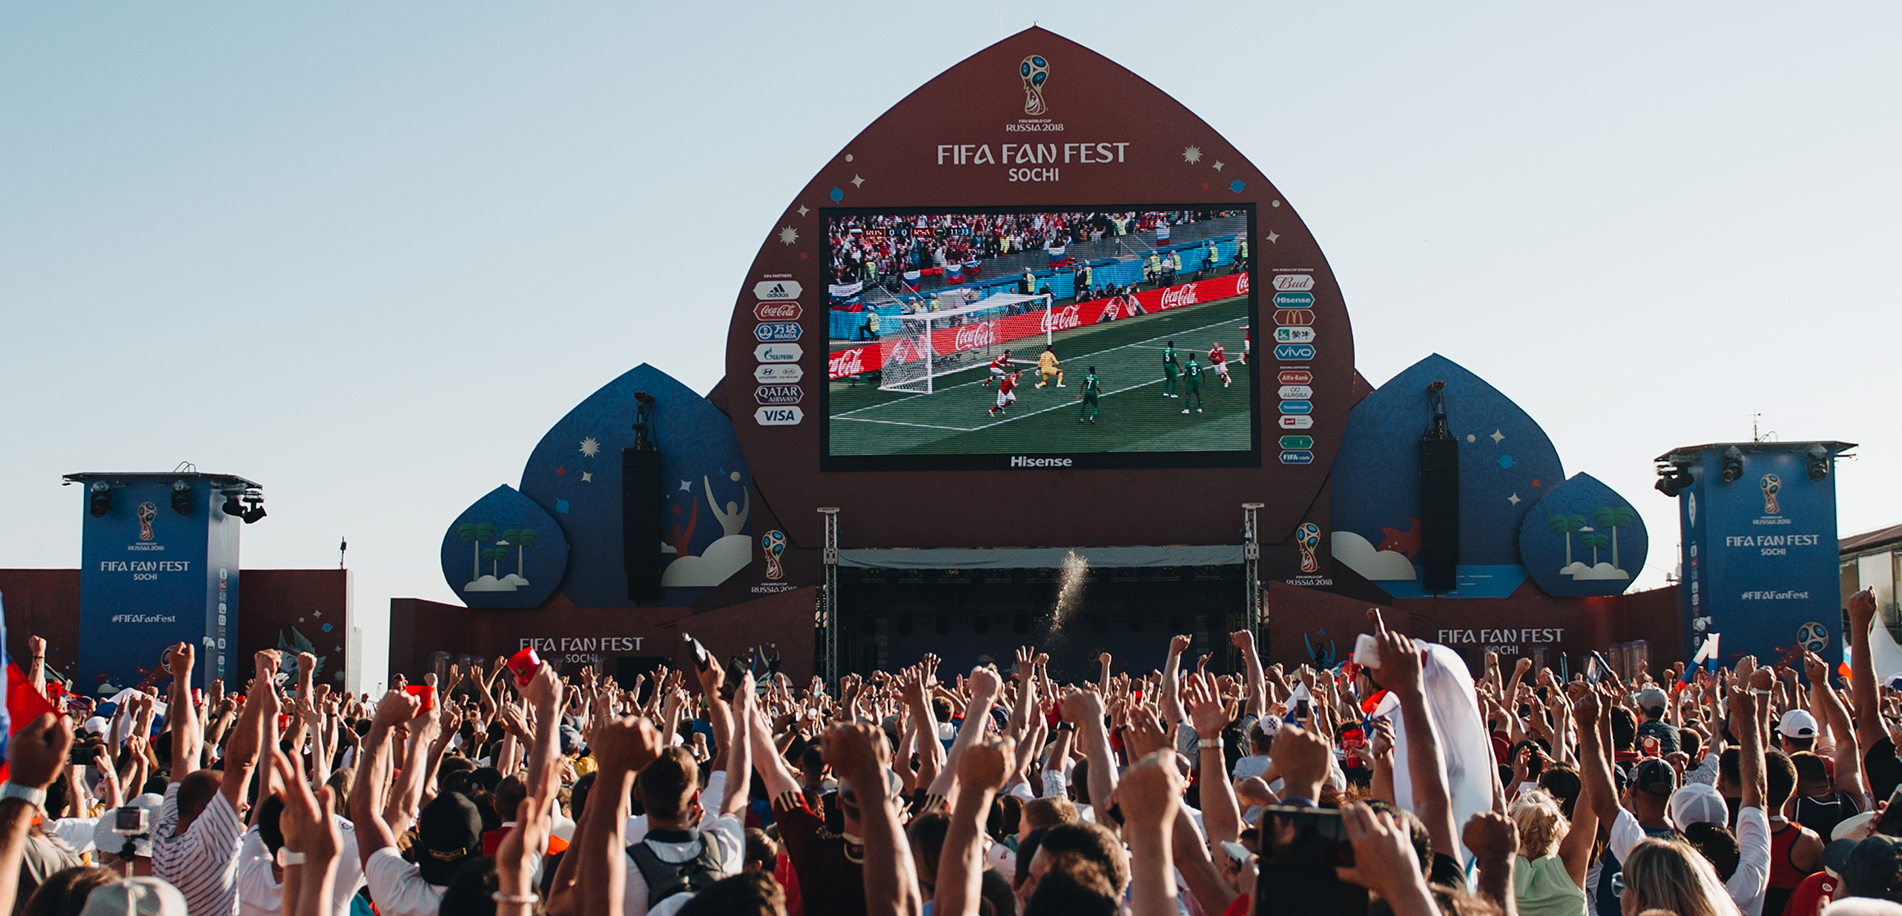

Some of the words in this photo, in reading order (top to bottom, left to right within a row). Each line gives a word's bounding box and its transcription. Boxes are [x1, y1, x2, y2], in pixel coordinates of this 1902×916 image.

[1006, 124, 1041, 132] RUSSIA
[1042, 124, 1064, 132] 2018
[938, 144, 995, 165] FIFA
[1002, 144, 1056, 164] FAN
[1064, 142, 1130, 164] FEST
[1009, 168, 1059, 182] SOCHI
[1276, 276, 1310, 289] Bud
[774, 324, 797, 333] 万达
[1278, 347, 1312, 356] vivo
[1191, 367, 1197, 376] 3
[759, 386, 798, 397] QATAR
[762, 410, 795, 421] VISA
[1011, 456, 1072, 467] Hisense
[1726, 536, 1754, 546] FIFA
[1757, 535, 1784, 546] FAN
[1788, 535, 1820, 546] FEST
[101, 561, 128, 571] FIFA
[131, 561, 157, 571] FAN
[159, 561, 190, 571] FEST
[1742, 591, 1808, 600] #FIFAFanFest
[112, 614, 176, 623] #FIFAFanFest
[1438, 630, 1476, 644] FIFA
[1481, 629, 1517, 643] FAN
[1522, 628, 1564, 643] FEST
[520, 638, 556, 652] FIFA
[561, 638, 597, 652] FAN
[602, 637, 644, 651] FEST
[1485, 645, 1519, 655] SOCHI
[566, 653, 598, 663] SOCHI
